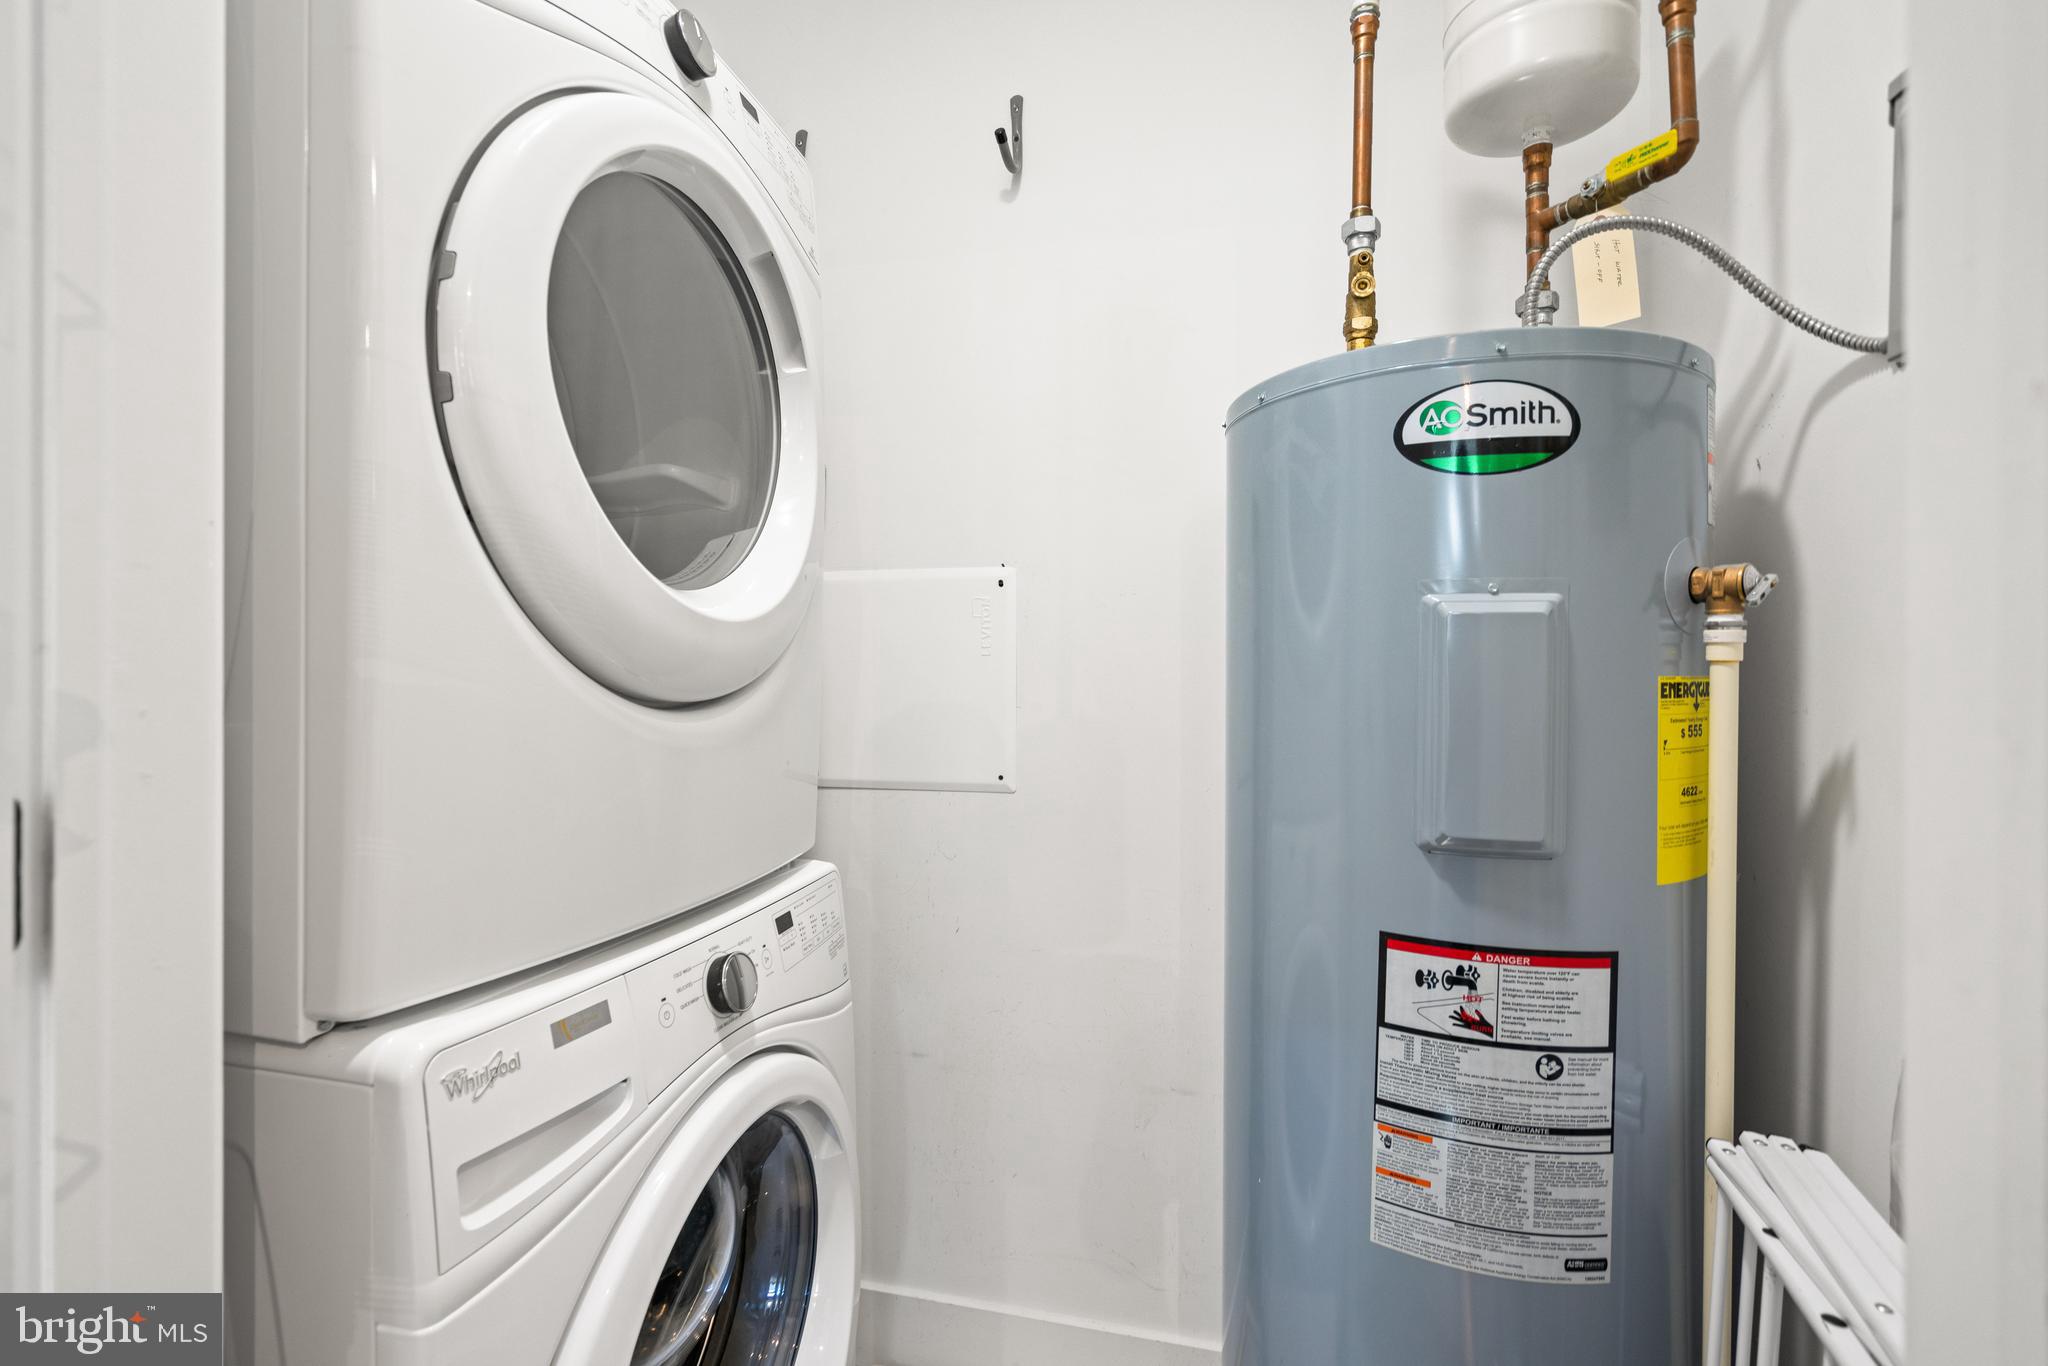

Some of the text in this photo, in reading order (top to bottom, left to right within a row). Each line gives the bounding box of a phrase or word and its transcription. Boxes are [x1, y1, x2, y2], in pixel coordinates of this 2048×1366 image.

[1688, 724, 1702, 738] 555
[1682, 786, 1698, 797] 4622
[1486, 954, 1530, 966] DANGER
[441, 1050, 522, 1103] Whirlpool
[1452, 1117, 1496, 1129] IMPORTANT
[1501, 1124, 1549, 1135] IMPORTANTE
